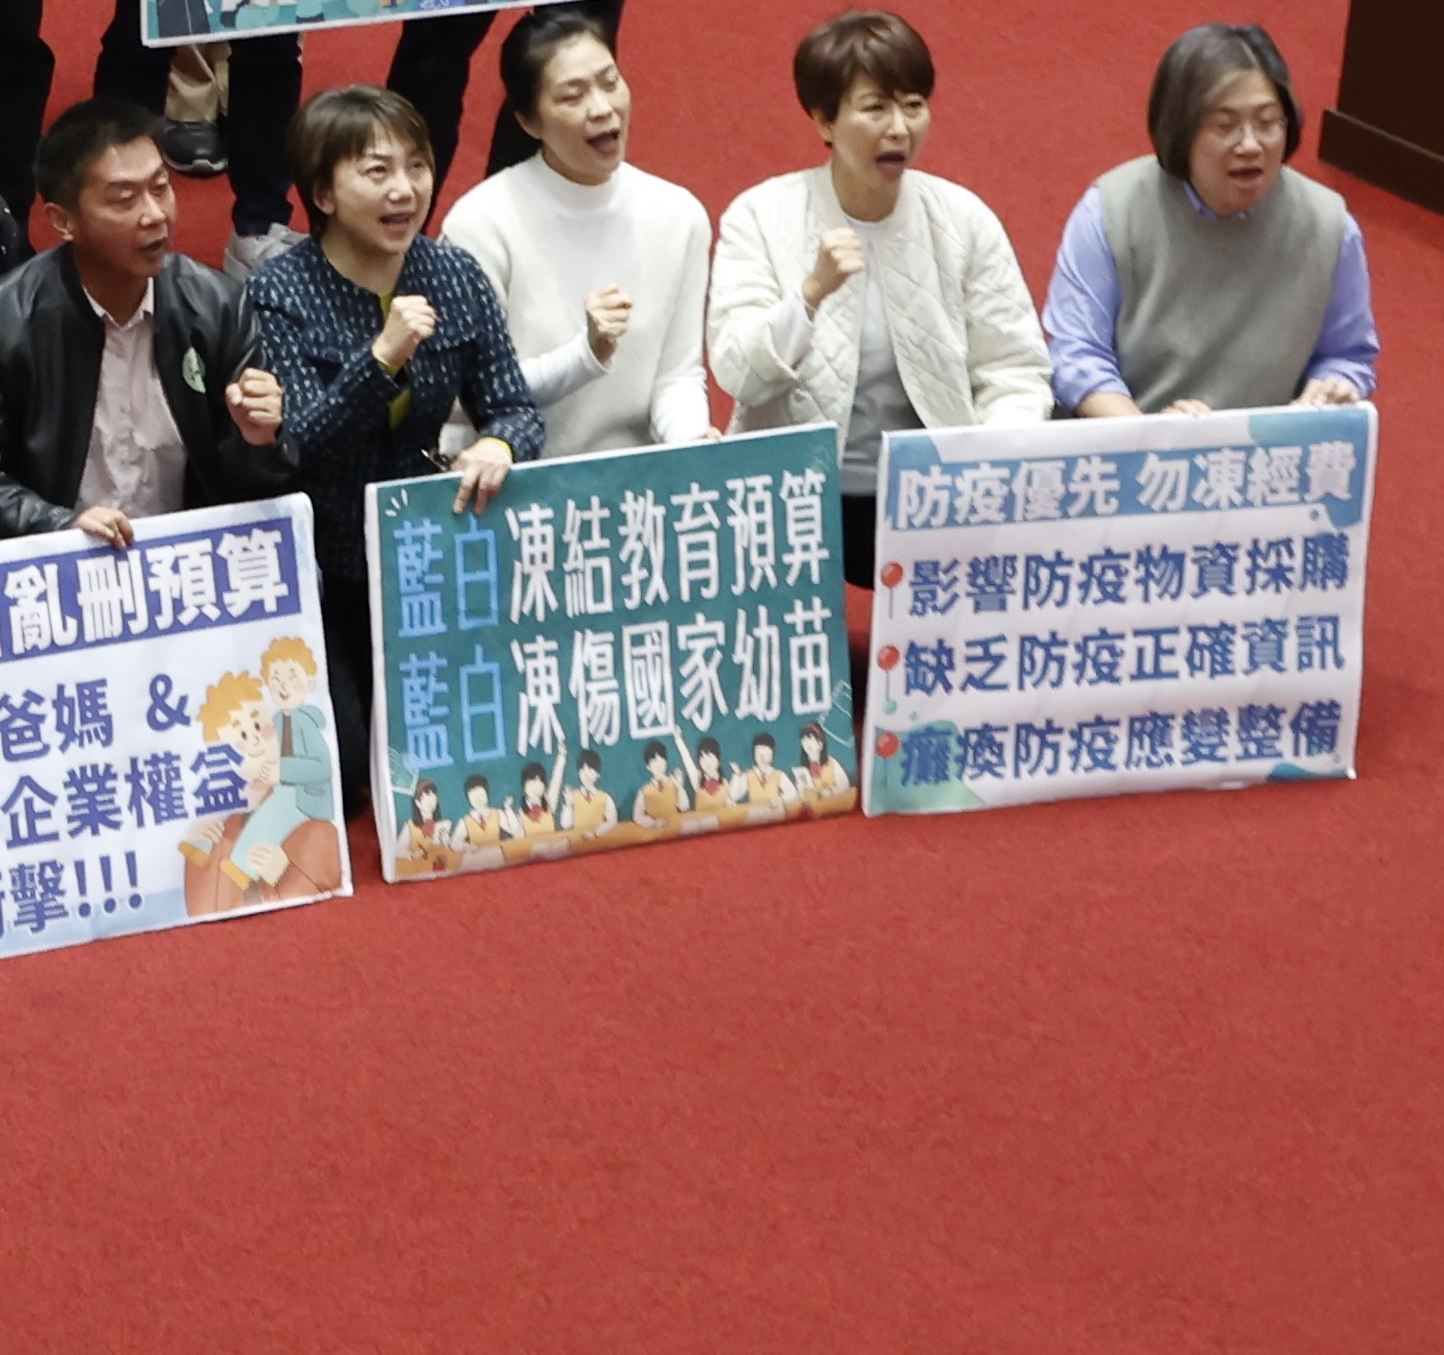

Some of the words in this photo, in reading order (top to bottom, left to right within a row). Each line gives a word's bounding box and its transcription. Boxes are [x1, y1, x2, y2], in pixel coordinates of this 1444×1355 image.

[897, 455, 1121, 528] 防疫優先
[1135, 442, 1355, 512] 勿凍經費
[394, 469, 830, 638] 藍白凍結教育預算
[909, 533, 1350, 617] 影響防疫物資採購
[399, 597, 833, 770] 藍白凍傷國家幼苗
[905, 616, 1345, 697] 缺乏防疫正確資訊
[146, 673, 192, 732] &
[899, 699, 1341, 786] 癱瘓防疫應變整備
